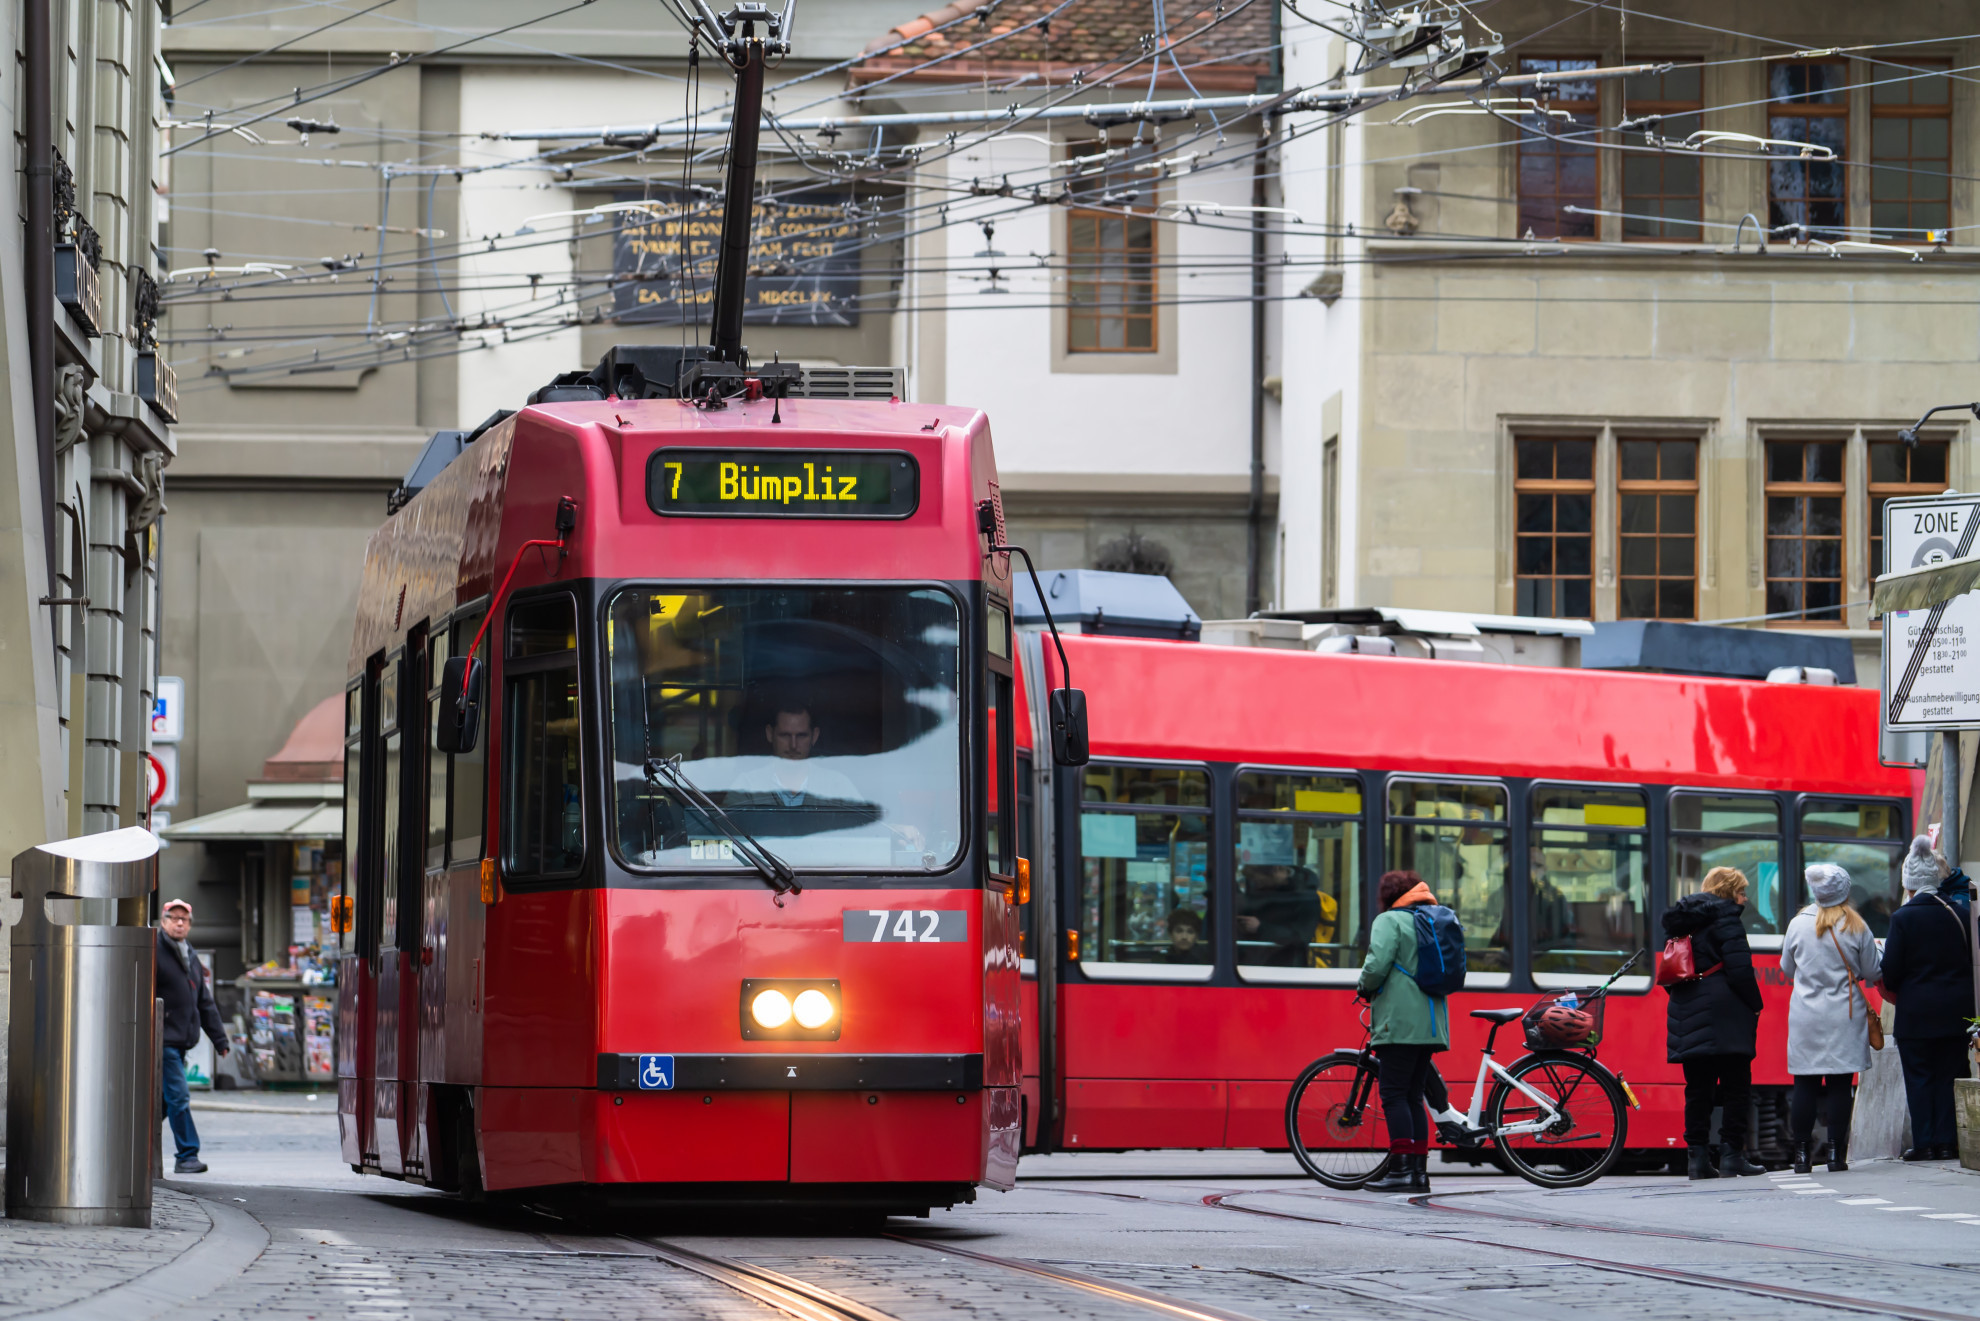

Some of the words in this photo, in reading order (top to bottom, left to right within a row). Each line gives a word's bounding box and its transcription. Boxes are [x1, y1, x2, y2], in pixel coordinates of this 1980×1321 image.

[664, 462, 682, 499] 7
[720, 462, 857, 504] Bümpliz
[1914, 511, 1959, 534] ZONE
[1907, 624, 1963, 636] Gütschlag
[1920, 665, 1954, 677] gestattet
[1922, 706, 1953, 718] gestattet
[869, 910, 940, 942] 742
